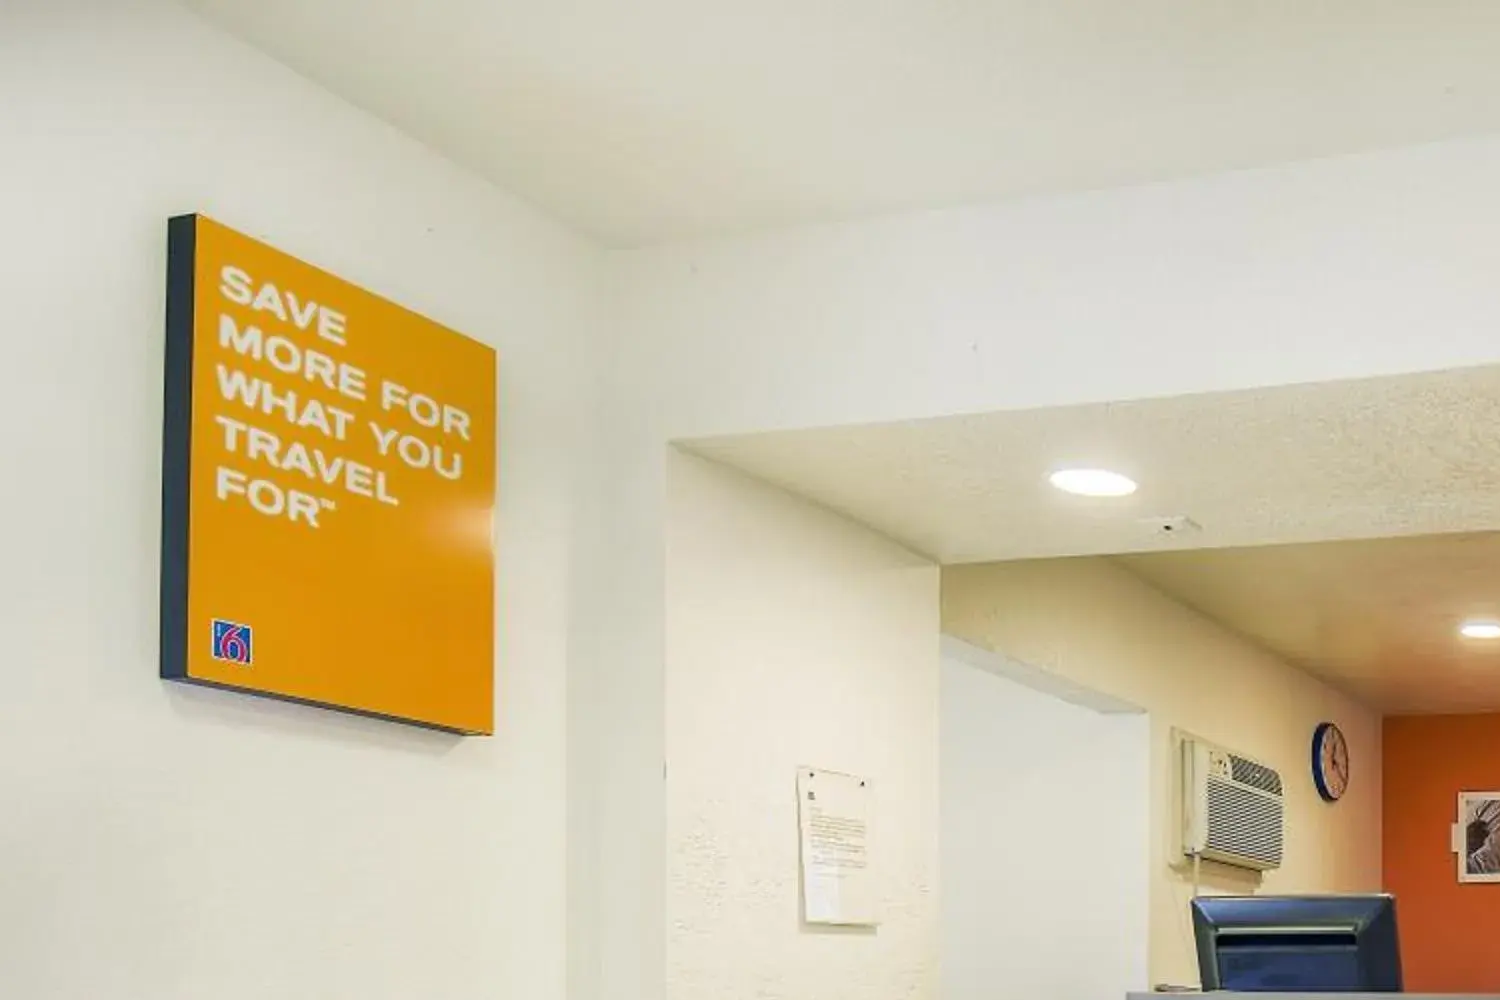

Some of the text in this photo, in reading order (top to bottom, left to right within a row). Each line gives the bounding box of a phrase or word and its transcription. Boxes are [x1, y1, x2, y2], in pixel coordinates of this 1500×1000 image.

[220, 265, 347, 346] SAVE
[218, 364, 463, 480] WHAT YOU
[219, 314, 472, 441] MORE FOR
[215, 416, 399, 506] TRAVEL
